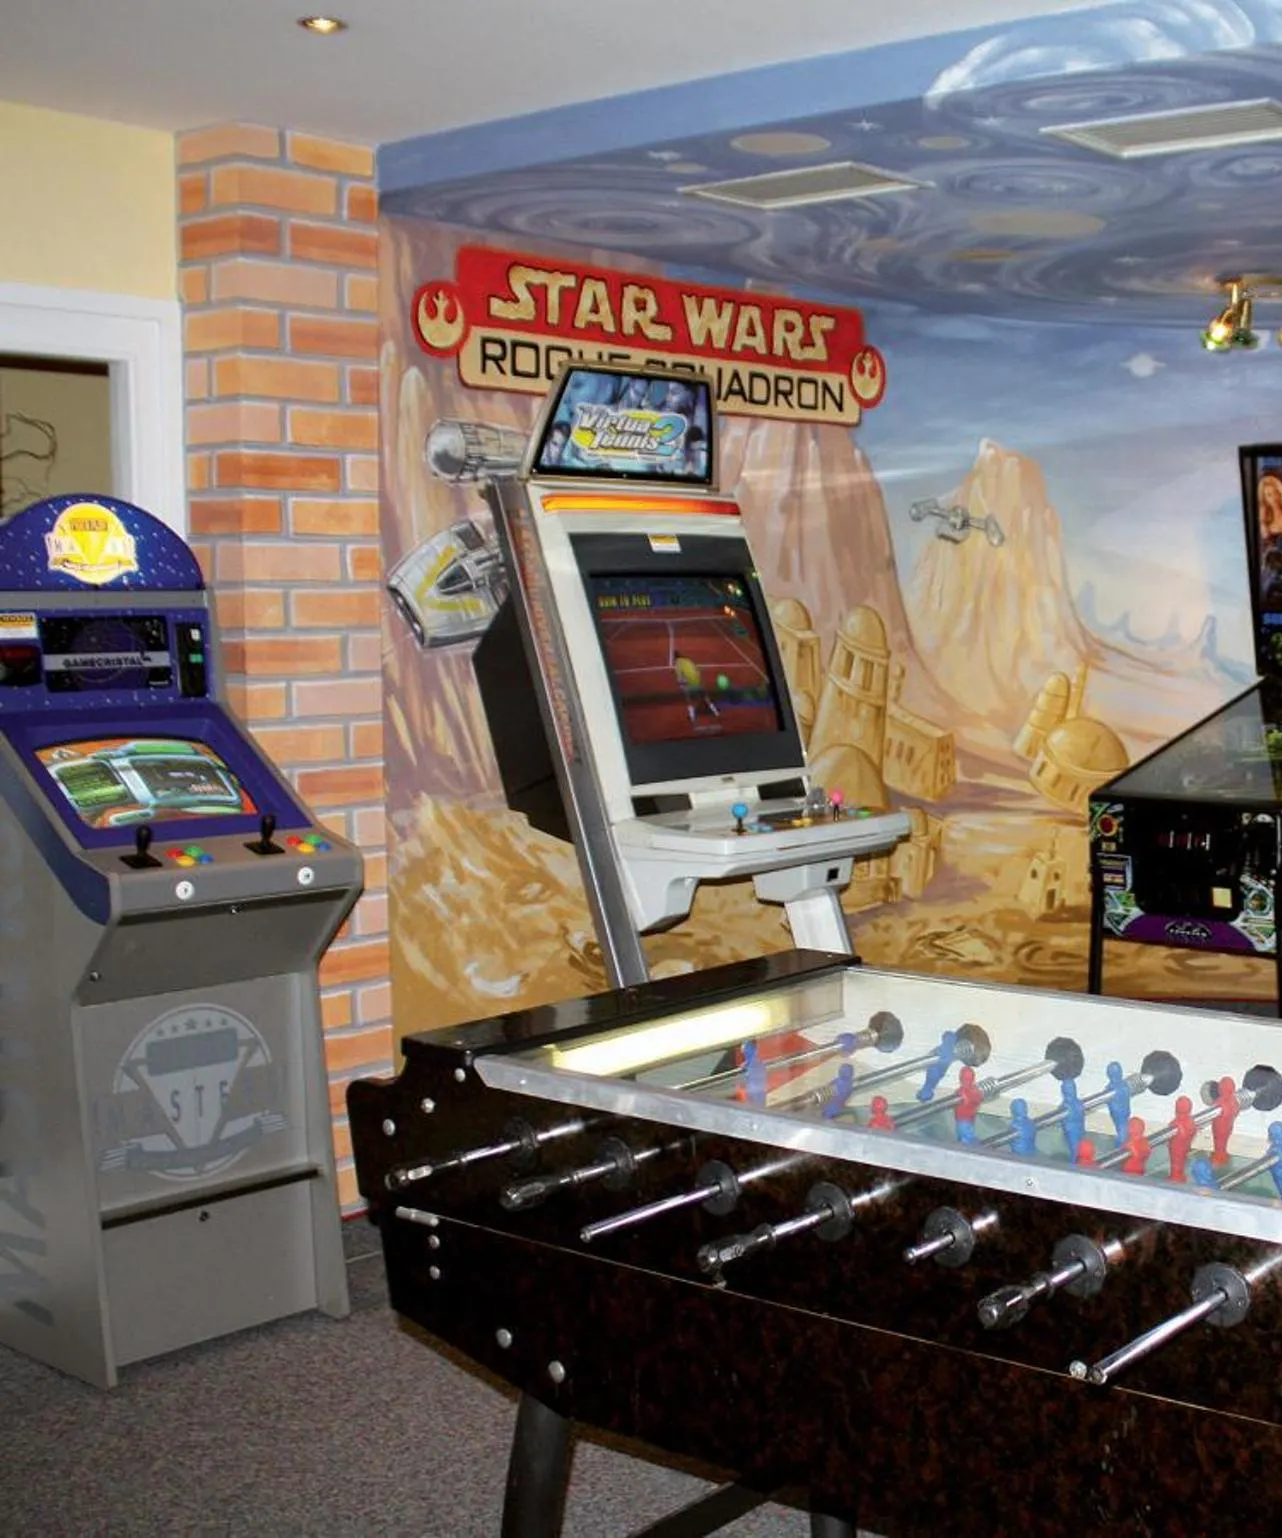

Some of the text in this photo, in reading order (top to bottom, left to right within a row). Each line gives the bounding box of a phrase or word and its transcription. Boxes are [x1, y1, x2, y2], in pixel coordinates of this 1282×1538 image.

[488, 263, 836, 362] STAR WARS
[577, 404, 651, 433] Virtua
[588, 429, 660, 450] Tennis
